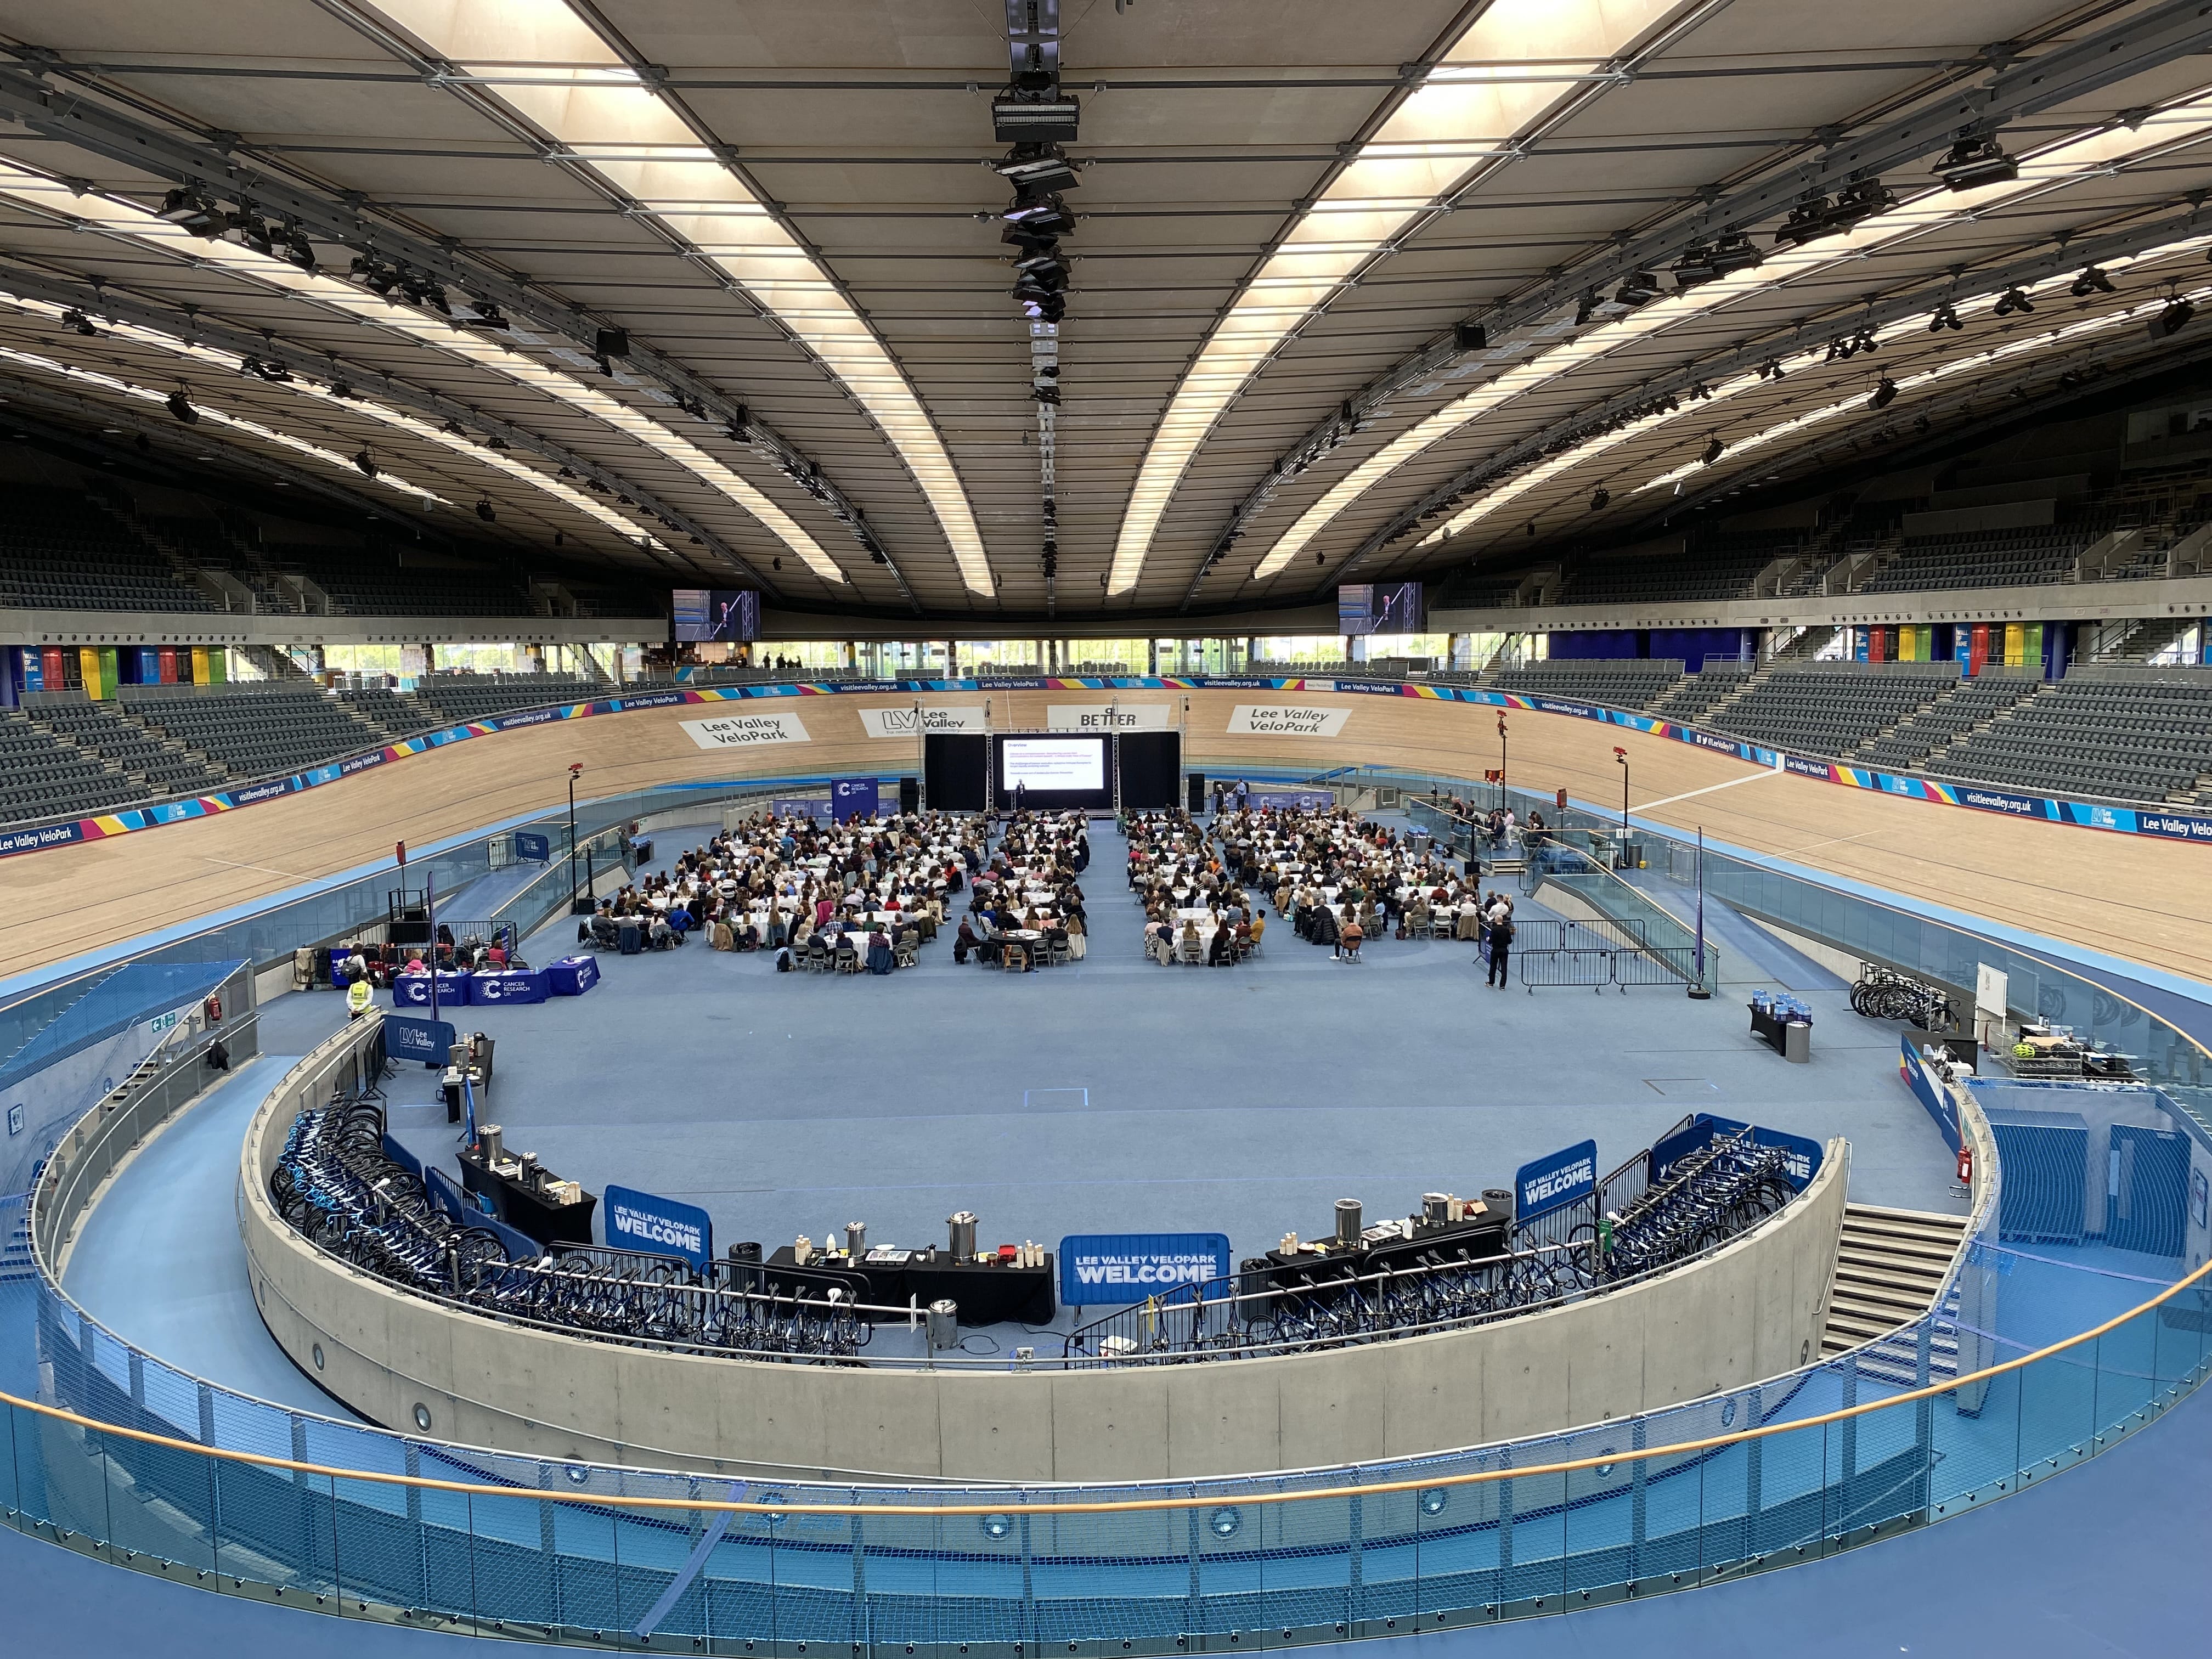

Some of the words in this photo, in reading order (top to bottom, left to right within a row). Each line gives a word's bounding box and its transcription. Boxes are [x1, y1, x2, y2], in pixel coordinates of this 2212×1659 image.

[840, 683, 898, 691] visitleevalley.org.uk
[635, 699, 652, 707] Valley
[652, 696, 678, 705] VeloPark
[1542, 702, 1588, 716] visitleevalley.org.uk
[503, 712, 551, 726] visitleevalley.org.uk
[882, 710, 918, 729] LV
[1251, 708, 1278, 718] Lee
[1284, 709, 1329, 722] Valley
[701, 723, 731, 732] Lee
[730, 718, 780, 730] Valley
[923, 719, 965, 728] Valley
[1250, 721, 1319, 732] VeloPark
[712, 729, 788, 743] VeloPark
[1708, 737, 1734, 752] @LeeValleyVP
[351, 760, 363, 771] Valley
[363, 753, 380, 766] VeloPark
[1795, 760, 1808, 773] Valley
[1809, 763, 1828, 776] VeloPark
[239, 783, 285, 802] visitleevalley.org.uk
[1967, 793, 2032, 812] visitleevalley.org.uk
[2143, 816, 2159, 830] Lee
[2160, 818, 2190, 837] Valley
[0, 839, 13, 850] Lee
[14, 833, 38, 848] Valley
[40, 827, 72, 842] VeloPark
[399, 1027, 415, 1045] LV
[415, 1029, 427, 1038] Lee
[415, 1037, 435, 1048] Valley
[1525, 1180, 1537, 1190] LEE
[1537, 1170, 1560, 1185] VALLEY
[1560, 1157, 1592, 1175] VELOPARK
[1525, 1165, 1593, 1205] WELCOME
[614, 1205, 627, 1216] LEE
[629, 1209, 658, 1223] VALLEY
[658, 1217, 701, 1236] VELOPARK
[615, 1214, 701, 1254] WELCOME
[1075, 1256, 1098, 1265] LEE
[1101, 1256, 1148, 1265] VALLEY
[1150, 1255, 1216, 1264] VELOPARK
[1076, 1265, 1216, 1284] WELCOME
